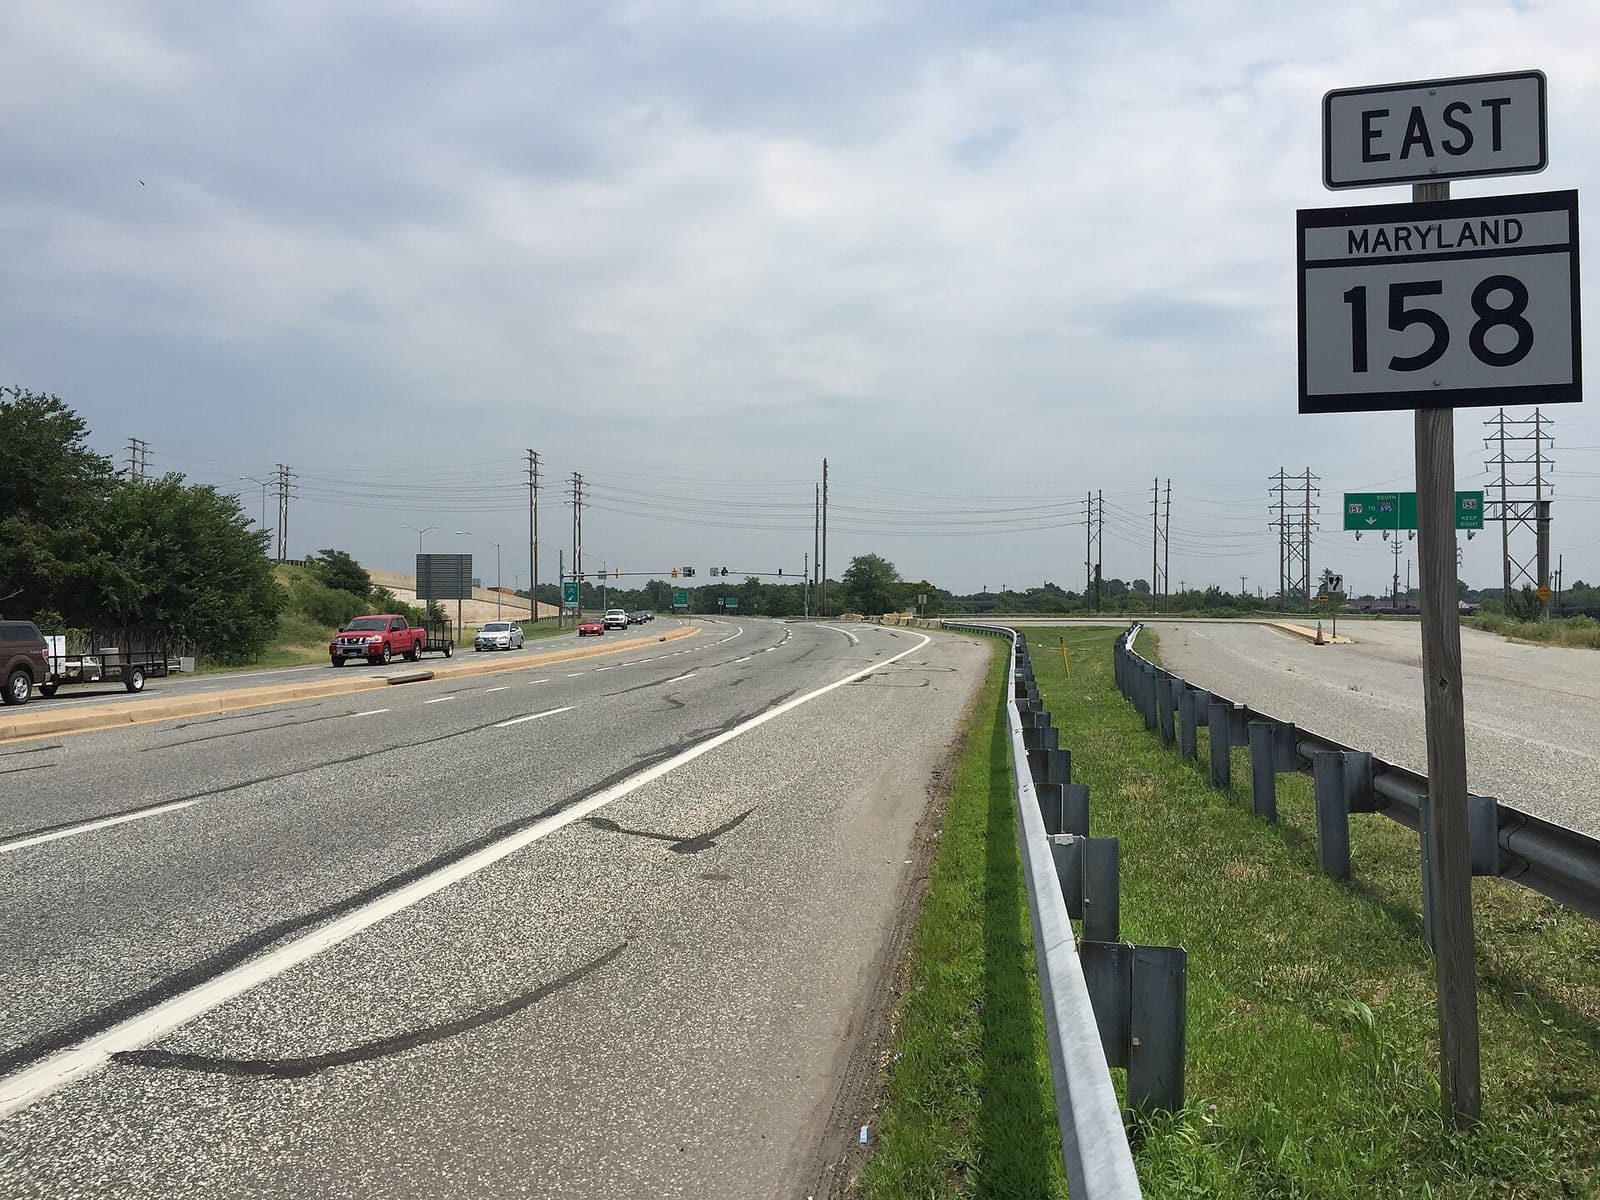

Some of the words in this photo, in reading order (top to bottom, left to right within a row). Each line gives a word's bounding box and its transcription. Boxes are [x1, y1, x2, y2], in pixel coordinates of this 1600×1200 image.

[1361, 97, 1512, 164] EAST
[1347, 218, 1523, 255] MARYLAND
[1343, 274, 1535, 374] 158
